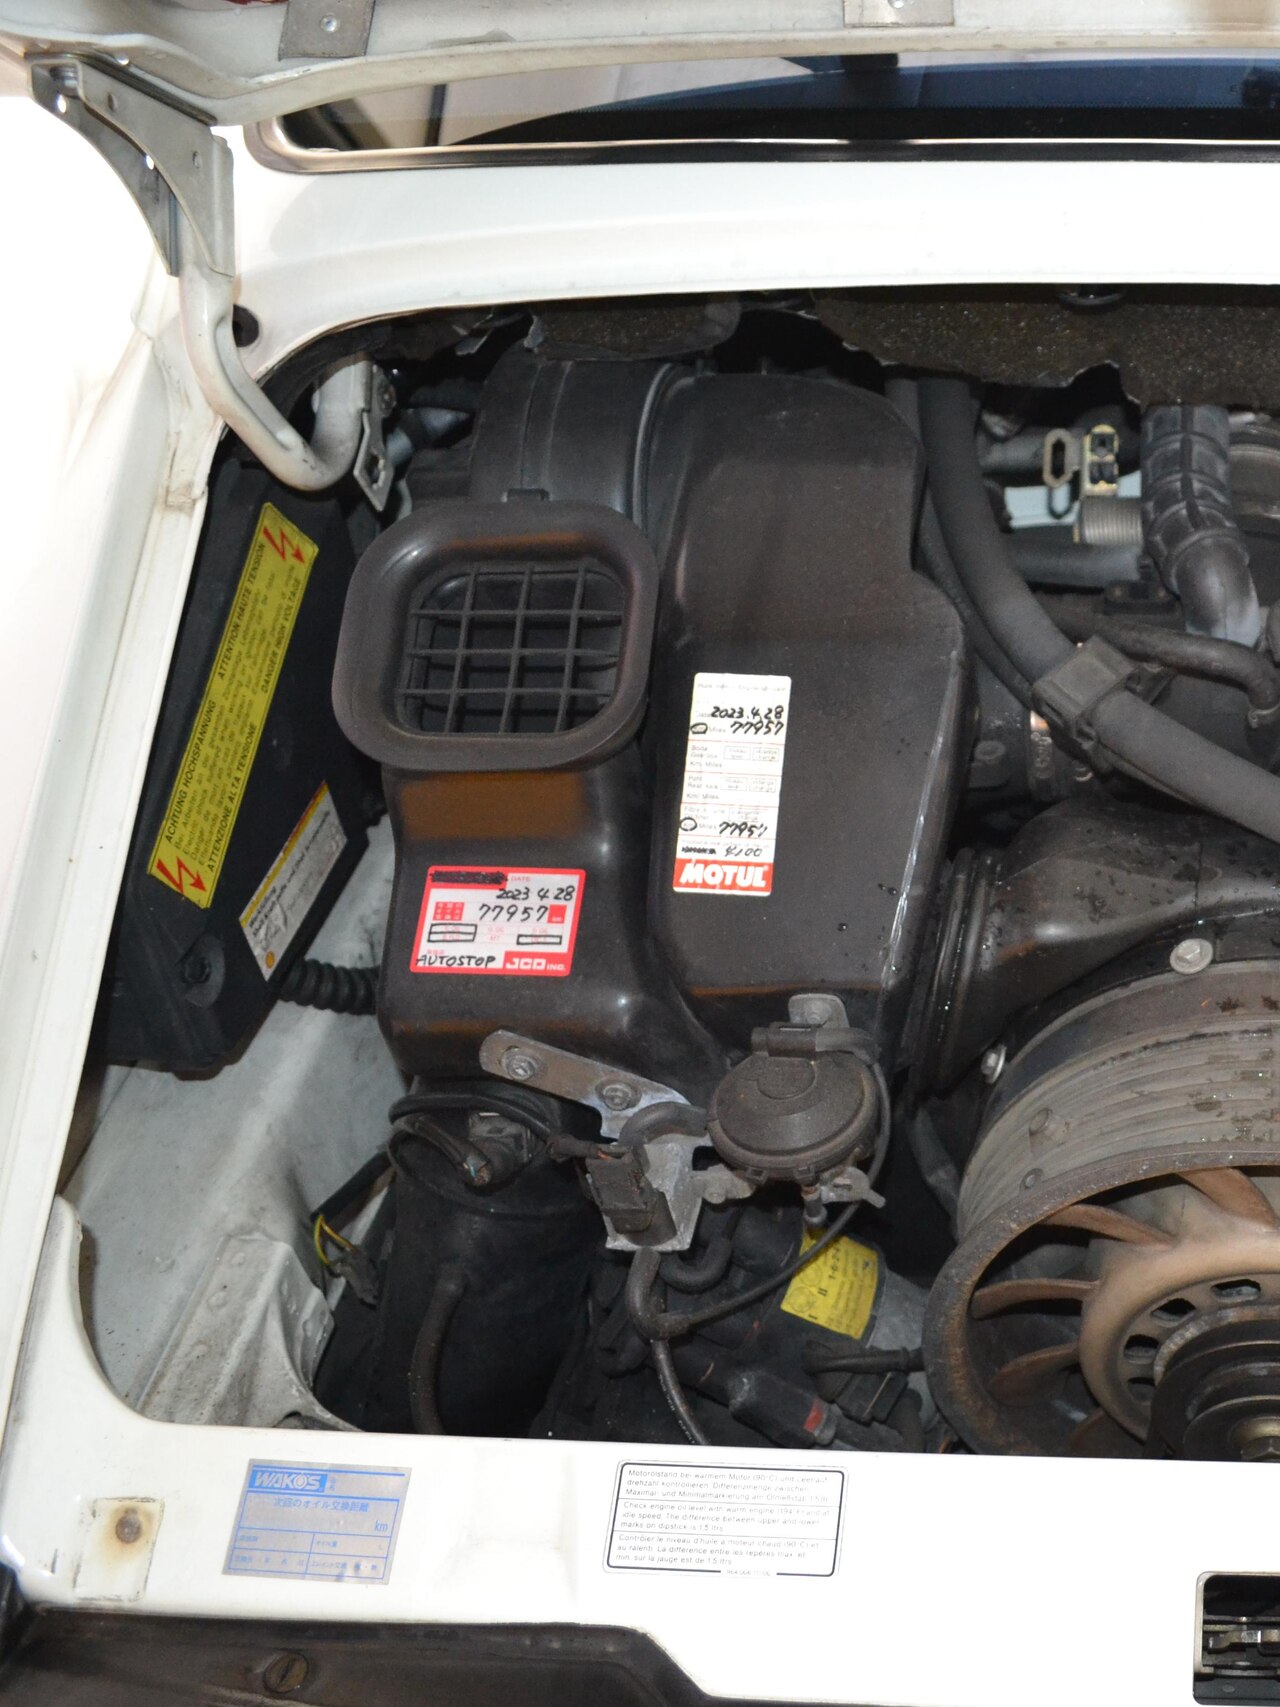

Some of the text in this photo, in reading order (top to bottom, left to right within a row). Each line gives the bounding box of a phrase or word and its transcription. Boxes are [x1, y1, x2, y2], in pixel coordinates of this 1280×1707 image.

[218, 542, 266, 680] ATTENTION HAUTE TENSION
[261, 650, 278, 693] DANGER
[283, 577, 301, 622] VOLTAGE
[730, 721, 785, 735] 77957
[165, 699, 216, 843] ACHTUNG HOCHSPANNUNG
[207, 722, 258, 872] ATTENZIONE ALTA TENSIONE
[680, 863, 769, 888] MOTUL
[495, 885, 576, 902] 2023 4 28
[479, 903, 549, 922] 77957
[415, 953, 496, 968] AUTOSTOP
[506, 957, 547, 971] JCD
[626, 1479, 659, 1487] drehzahl
[729, 1473, 751, 1481] Motor
[688, 1504, 706, 1512] level
[749, 1506, 774, 1514] engine
[620, 1521, 644, 1529] marks
[682, 1514, 720, 1522] difference
[374, 1520, 389, 1532] km
[666, 1536, 691, 1544] niveau
